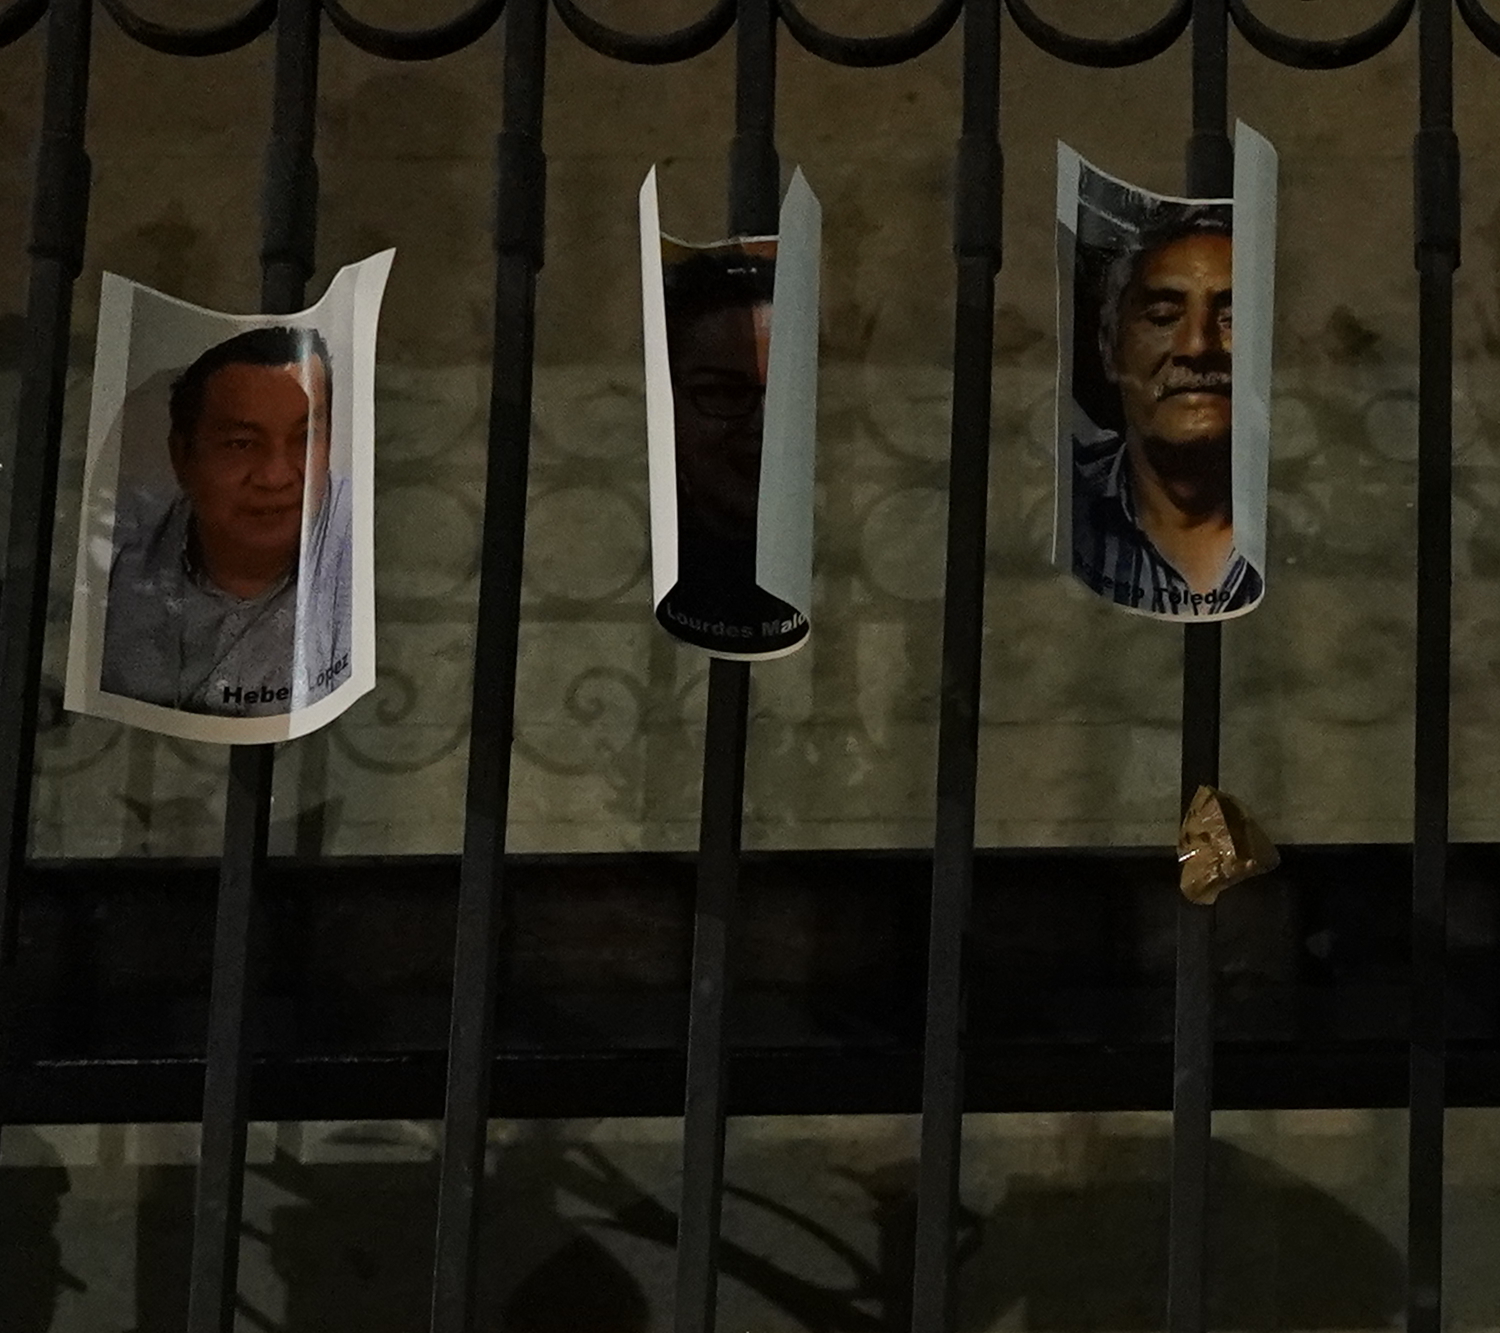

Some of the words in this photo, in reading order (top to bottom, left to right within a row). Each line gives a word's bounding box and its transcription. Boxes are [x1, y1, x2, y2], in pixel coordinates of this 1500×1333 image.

[1153, 585, 1231, 605] Toledo
[666, 602, 753, 638] Lourdes
[222, 685, 295, 705] Hebe
